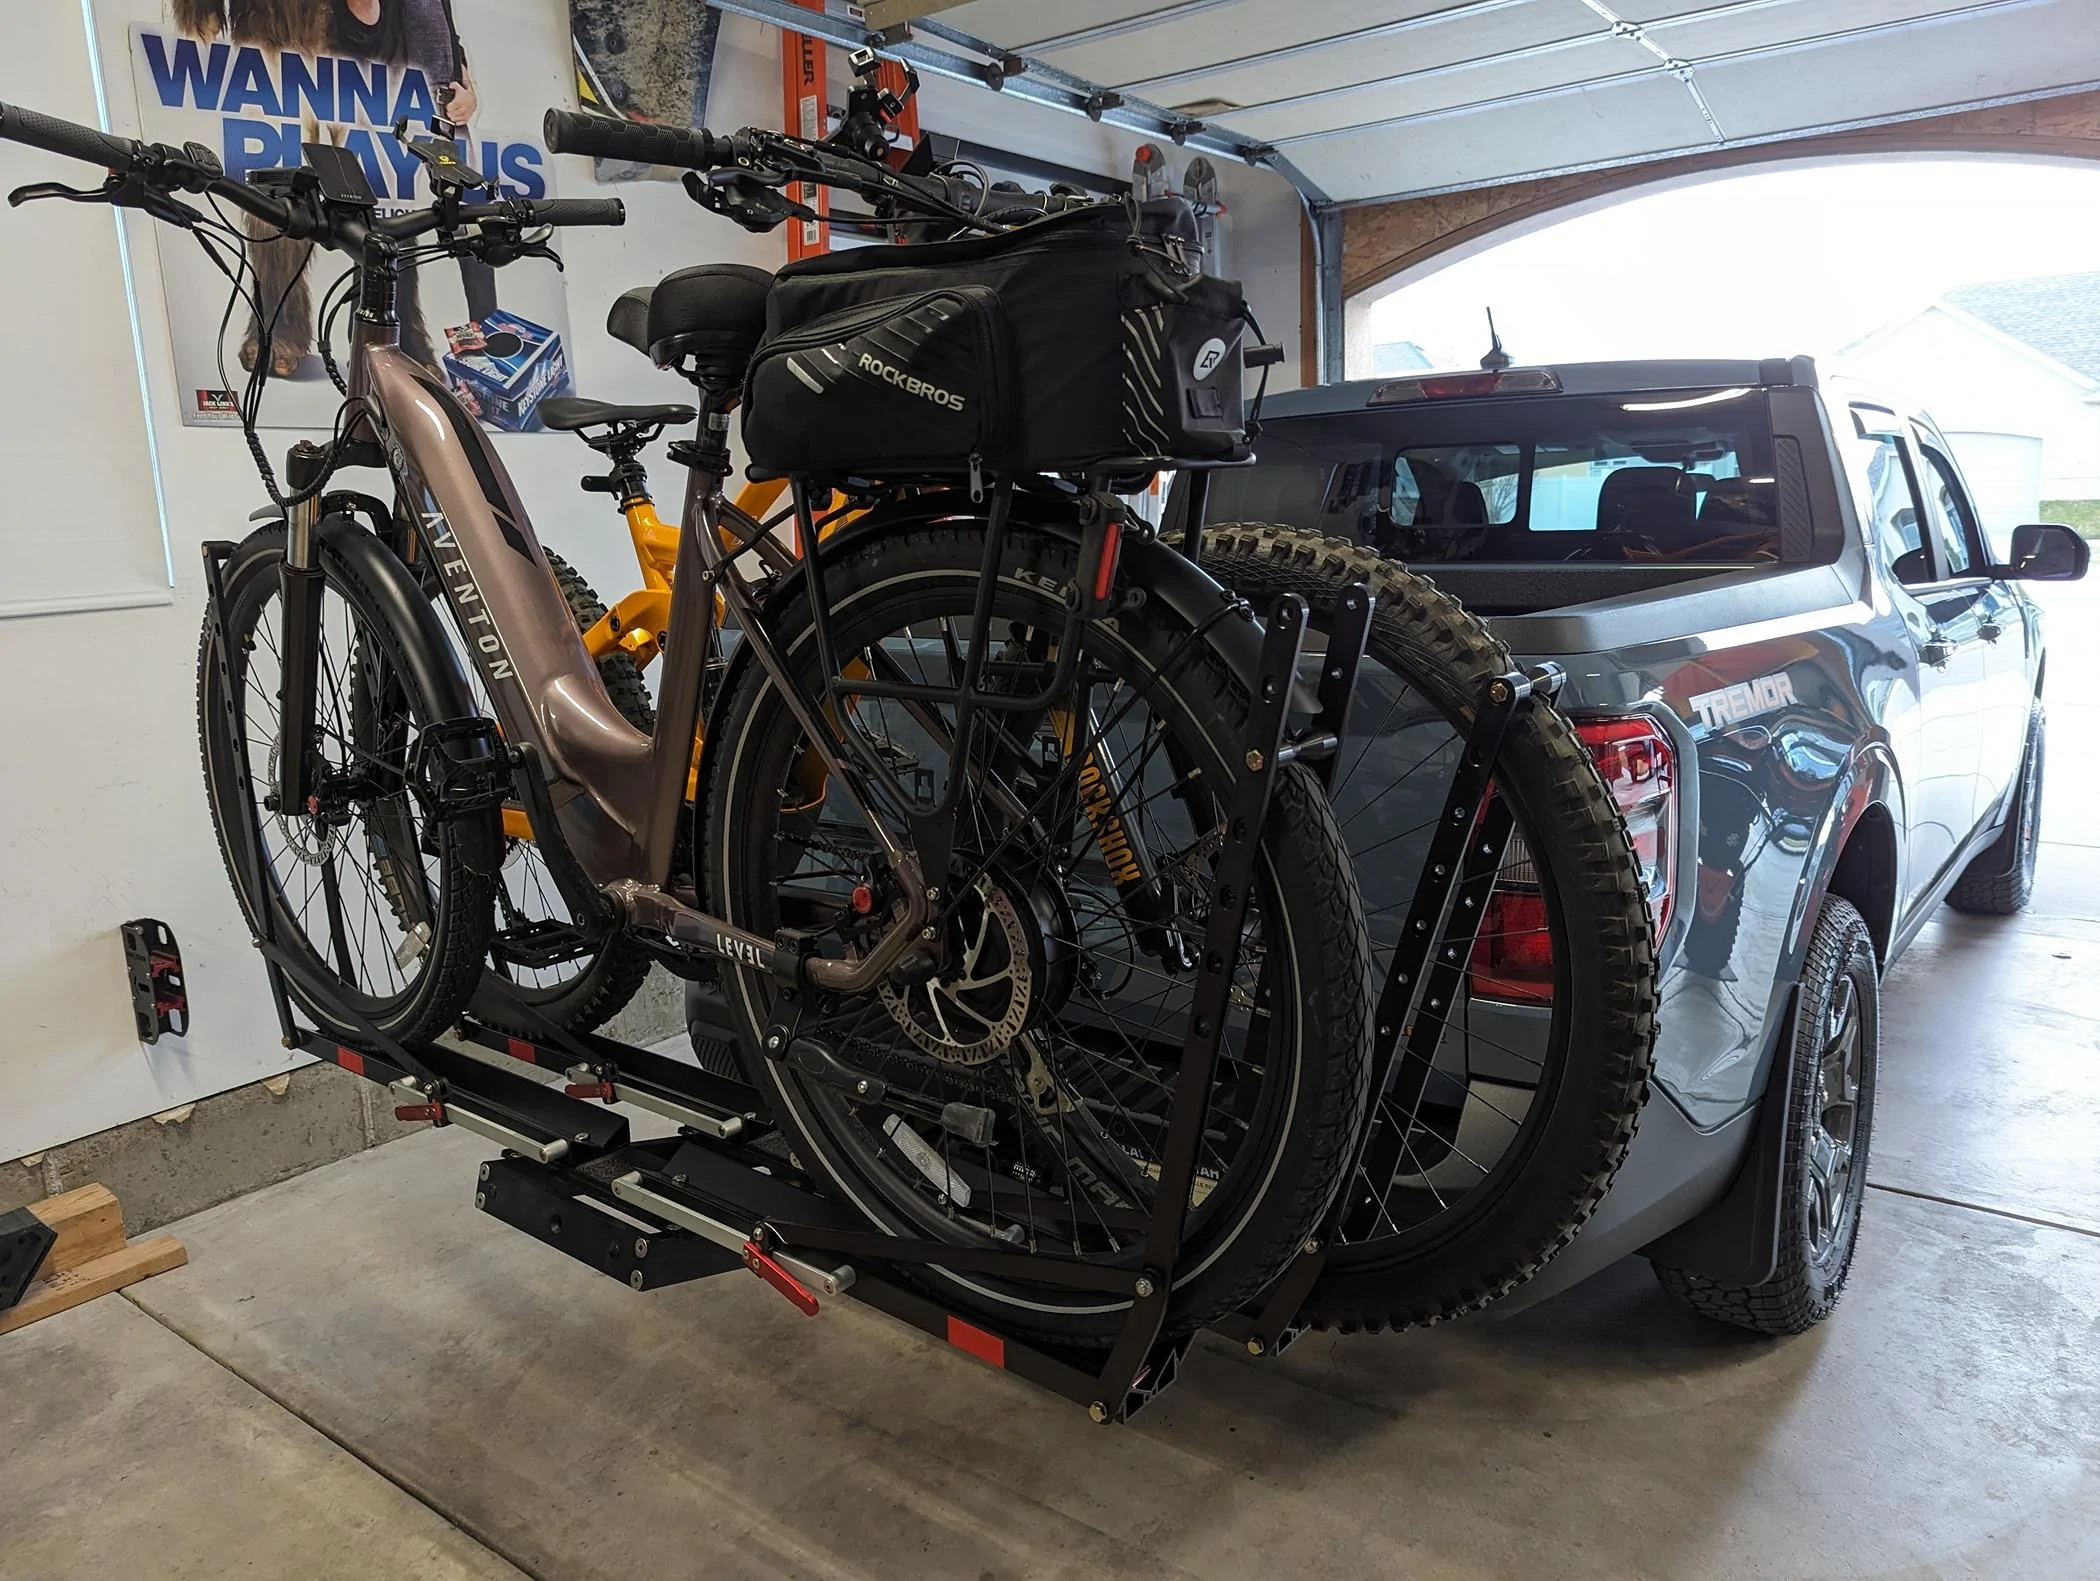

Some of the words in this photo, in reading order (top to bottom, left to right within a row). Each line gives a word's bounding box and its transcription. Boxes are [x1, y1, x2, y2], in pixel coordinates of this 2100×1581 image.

[141, 33, 437, 130] WANNA
[858, 353, 966, 411] ROCKBROS
[421, 512, 514, 680] AVENTON
[1013, 567, 1120, 634] KEA
[1688, 671, 1799, 733] TREMOR
[716, 933, 766, 969] LEVEL
